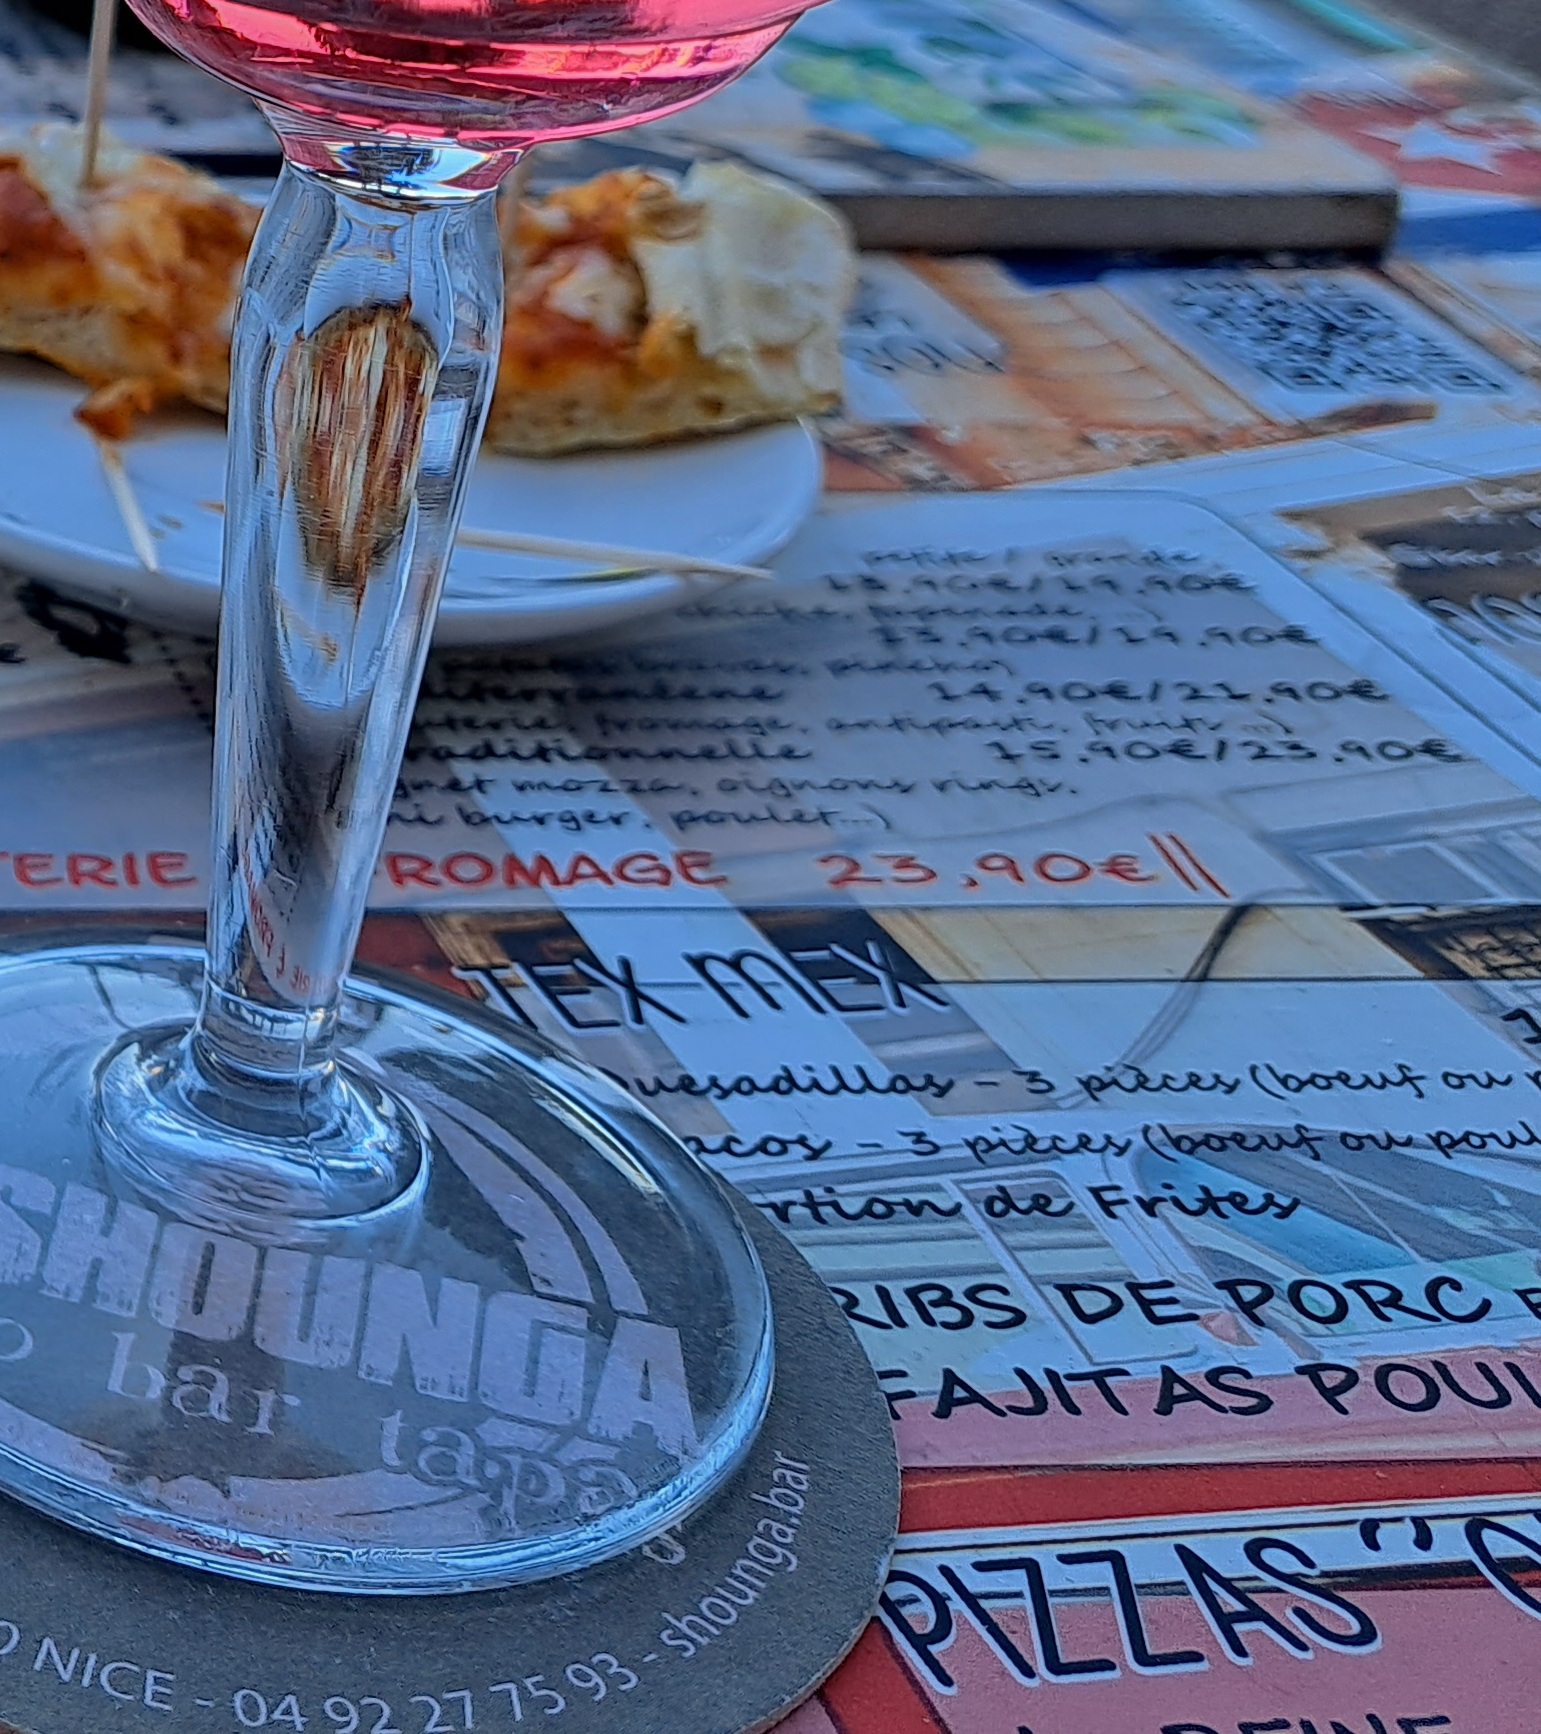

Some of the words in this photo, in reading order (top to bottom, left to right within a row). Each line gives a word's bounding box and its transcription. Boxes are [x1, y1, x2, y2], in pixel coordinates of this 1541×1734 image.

[384, 850, 728, 890] ROMAGE
[453, 954, 690, 1032] TEX
[618, 1065, 955, 1100] uesadillas
[1023, 1068, 1057, 1095] 3
[1076, 1063, 1242, 1102] pièces
[1441, 1070, 1514, 1091] ou
[895, 1129, 941, 1157] 3
[961, 1124, 1133, 1163] pièces
[1338, 1128, 1414, 1152] ou
[983, 1184, 1076, 1221] de
[1088, 1183, 1302, 1223] Frites
[1052, 1279, 1199, 1326] DE
[1216, 1275, 1494, 1328] PORC
[106, 1330, 302, 1436] bar
[33, 1636, 178, 1712] NICE
[232, 1686, 310, 1733] 04
[323, 1694, 403, 1734] 92
[408, 1688, 474, 1734] 27
[488, 1673, 567, 1722] 75
[565, 1652, 640, 1703] 93
[659, 1449, 812, 1659] shounga.bar
[880, 1537, 1381, 1691] PIZZAS
